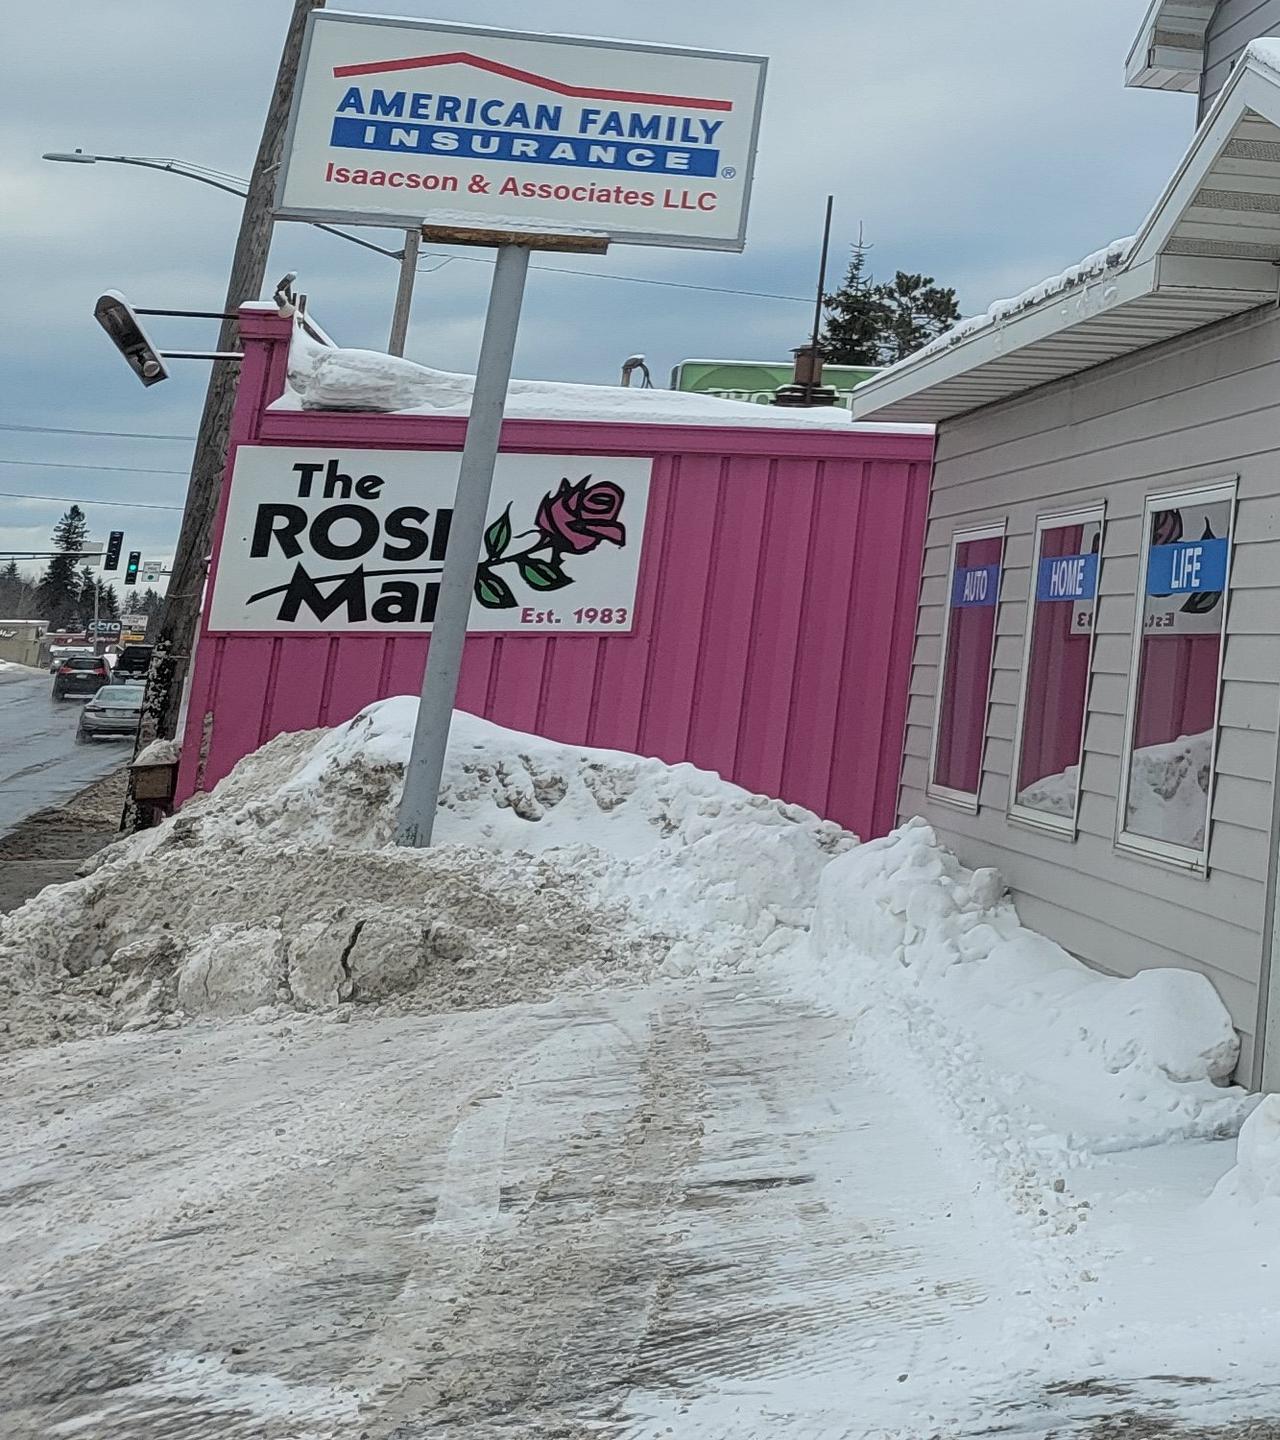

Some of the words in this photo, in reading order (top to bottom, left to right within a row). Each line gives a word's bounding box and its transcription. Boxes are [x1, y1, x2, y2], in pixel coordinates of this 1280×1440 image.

[336, 86, 562, 132] AMERICAN
[579, 108, 725, 146] FAMILY
[363, 126, 692, 171] INSURANCE
[325, 162, 459, 193] Isaacson
[468, 174, 491, 196] &
[500, 176, 656, 208] Associates
[663, 189, 718, 212] LLC
[292, 459, 385, 500] The
[963, 569, 988, 602] AUTO
[1049, 559, 1085, 597] HOME
[1171, 547, 1203, 589] LIFE
[520, 607, 562, 625] Est.
[573, 607, 628, 625] 1983
